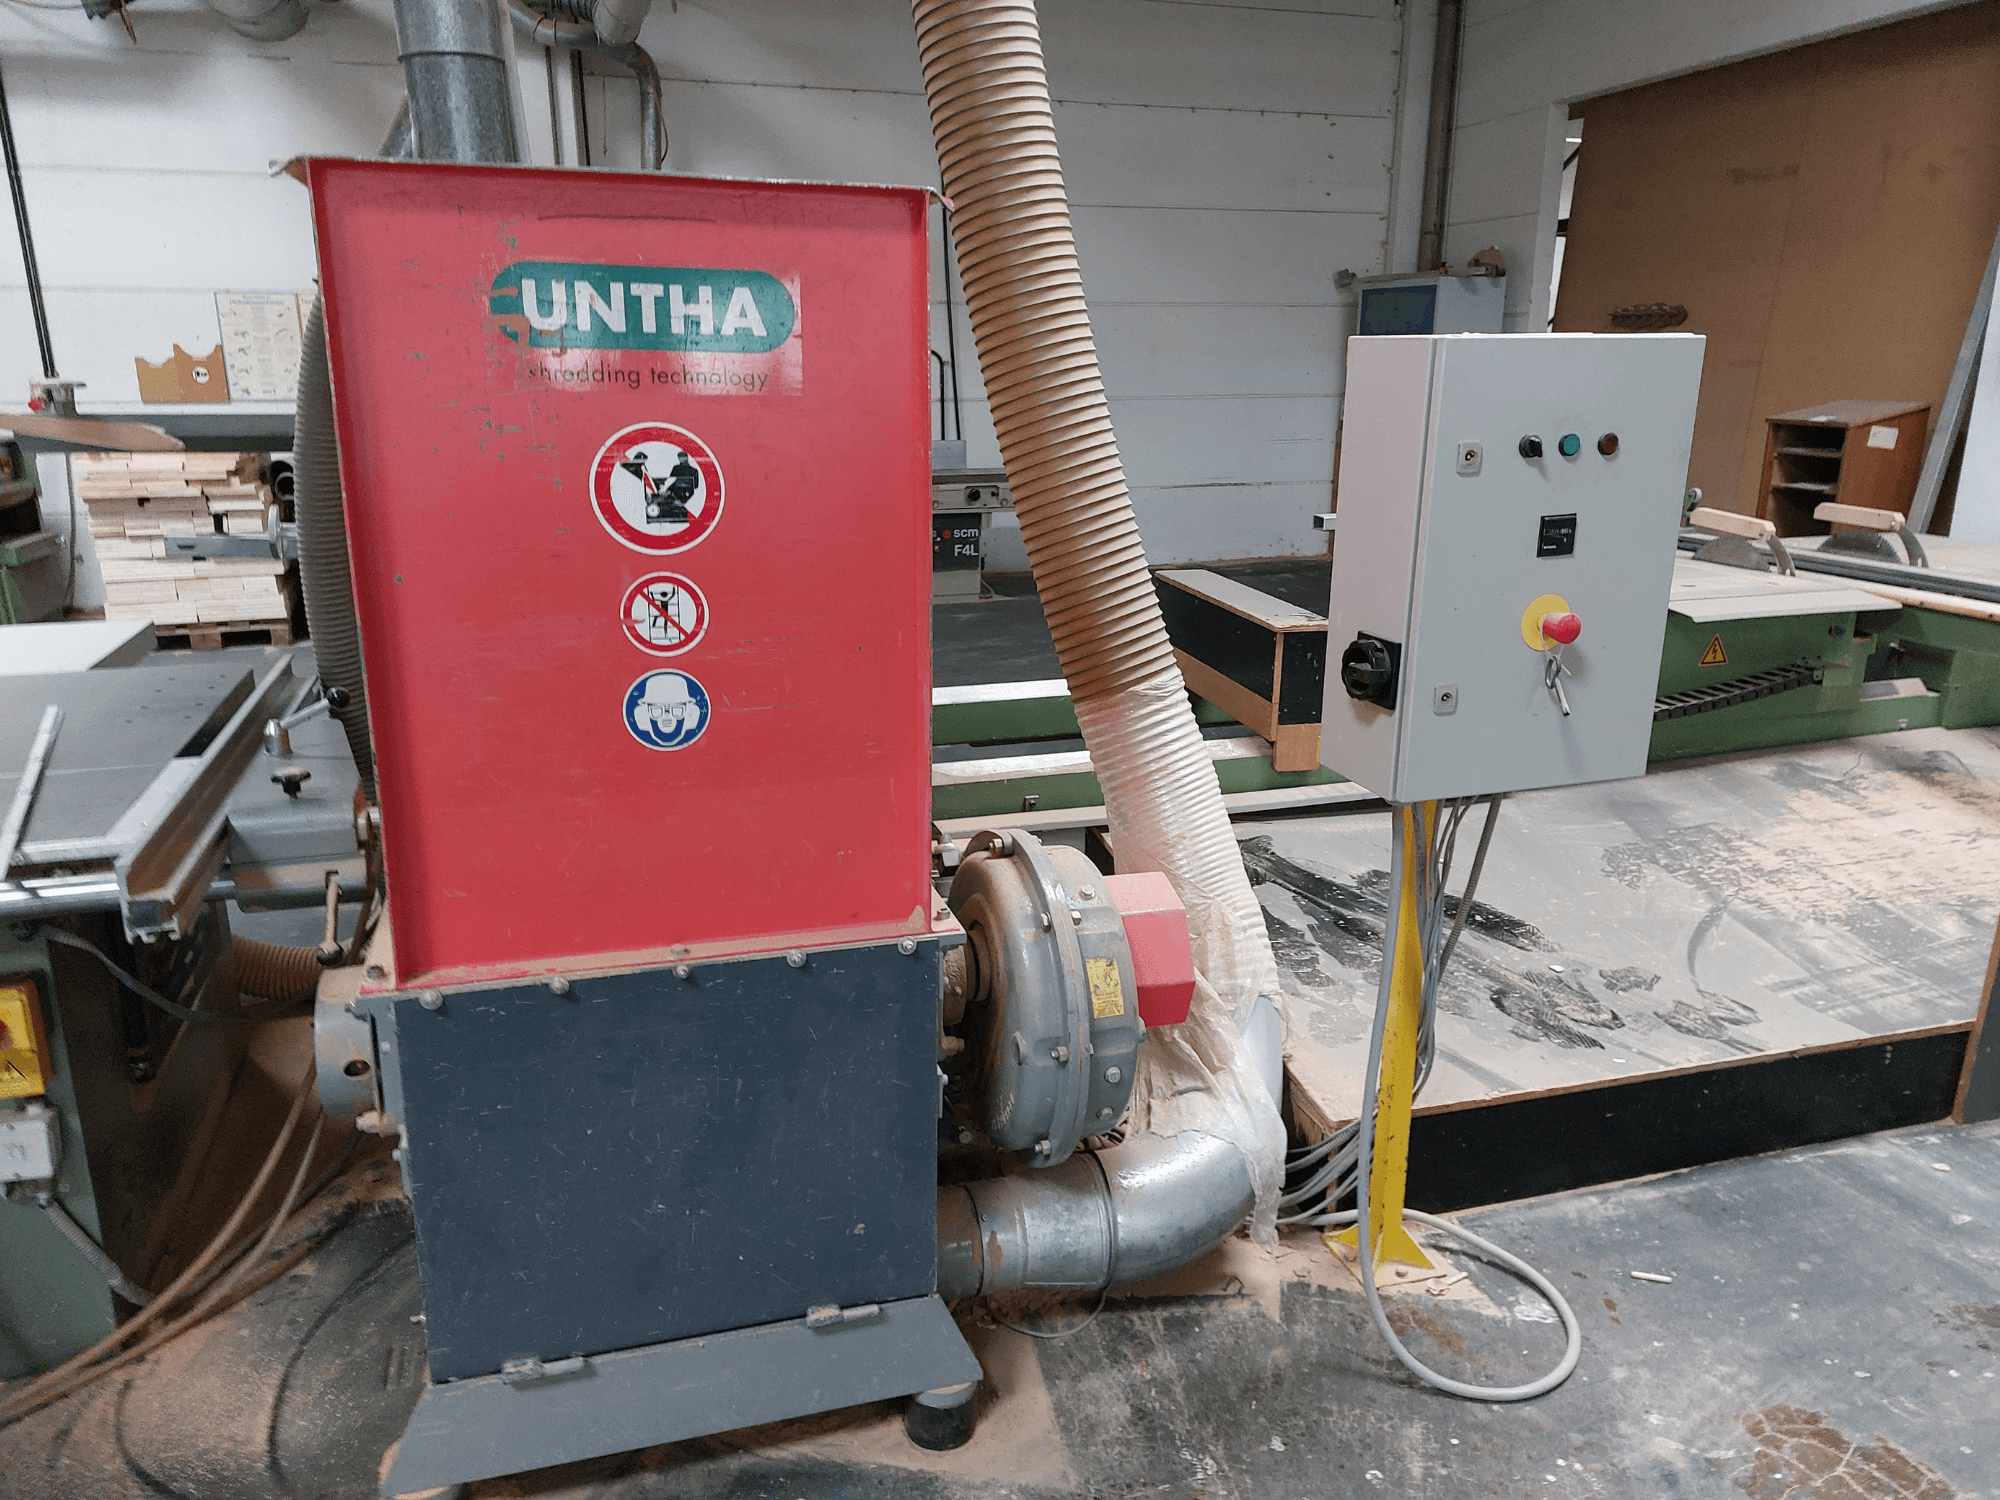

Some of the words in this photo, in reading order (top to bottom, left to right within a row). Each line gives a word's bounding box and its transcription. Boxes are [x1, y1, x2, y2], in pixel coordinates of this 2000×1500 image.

[521, 277, 768, 338] UNTHA
[651, 363, 768, 392] technology
[953, 528, 979, 538] scm
[954, 544, 979, 557] F4L
